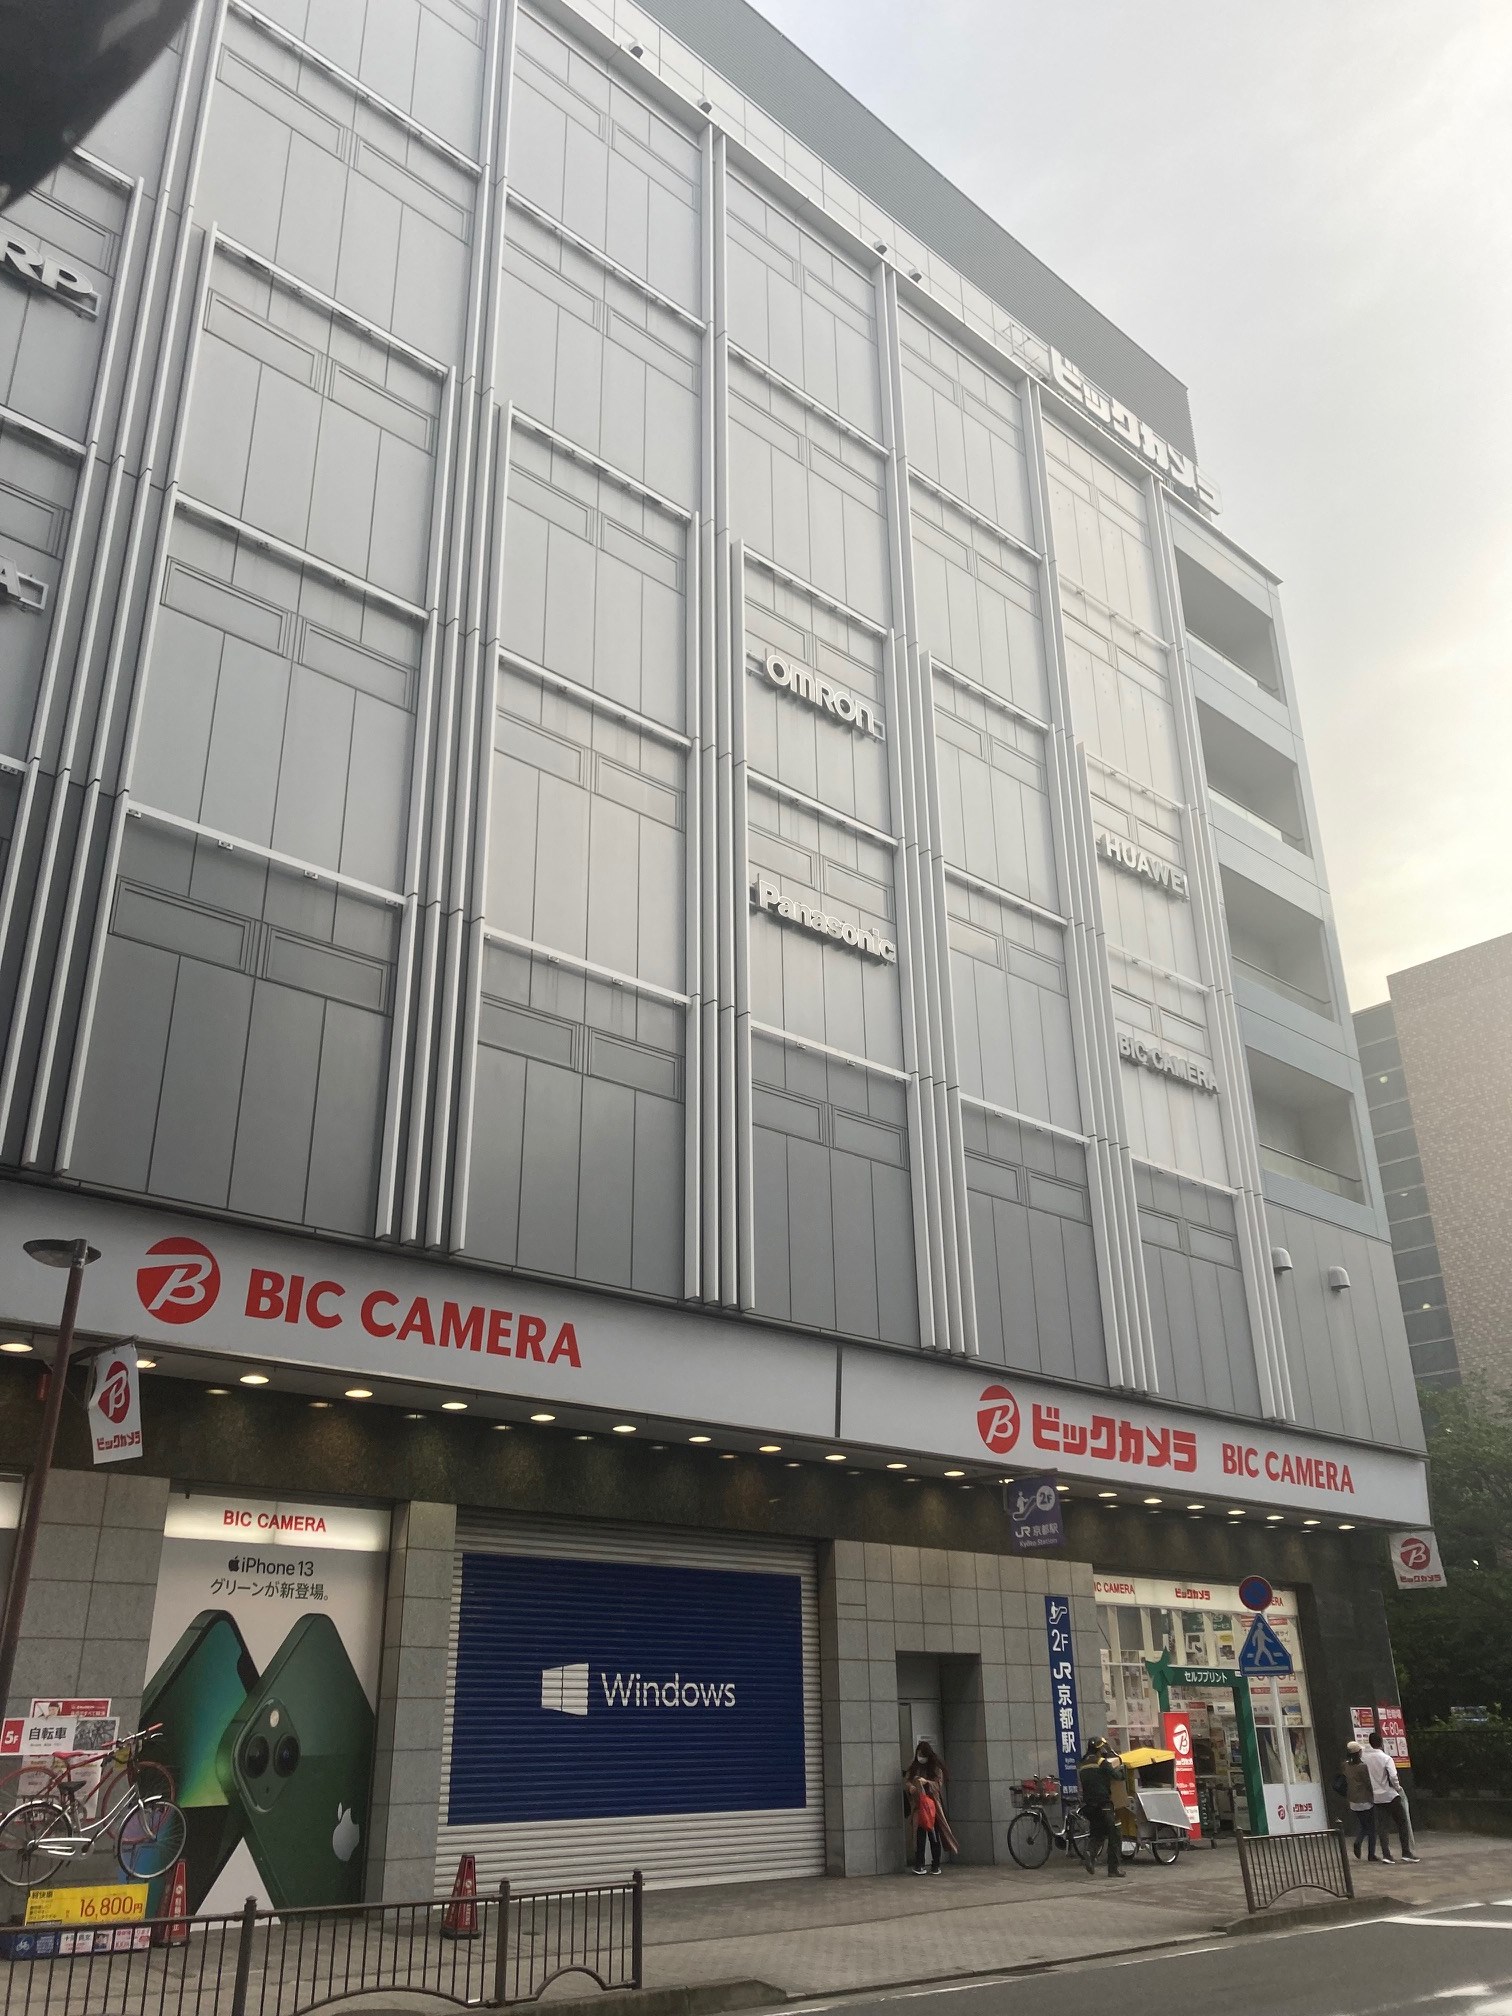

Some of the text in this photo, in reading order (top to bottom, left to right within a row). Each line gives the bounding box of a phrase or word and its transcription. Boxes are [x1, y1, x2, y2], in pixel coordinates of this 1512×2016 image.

[1105, 832, 1189, 898] HUAWEI
[759, 880, 895, 962] Panasonic
[1118, 1033, 1219, 1094] BIC CAMERA
[244, 1268, 346, 1329] BIC
[360, 1290, 582, 1368] CAMERA
[1032, 1403, 1197, 1473] ビックカメラ
[1222, 1443, 1259, 1478] BIC
[1265, 1451, 1355, 1494] CAMERA
[223, 1510, 327, 1533] BIC CAMERA
[241, 1557, 314, 1577] iPhone 13
[1103, 1582, 1135, 1595] CAMERA
[1174, 1587, 1211, 1601] ビックカメラ
[1051, 1629, 1068, 1652] 2F
[1184, 1670, 1228, 1684] セルフプリント
[601, 1672, 736, 1708] Windows
[4, 1727, 68, 1745] 5F 自転車
